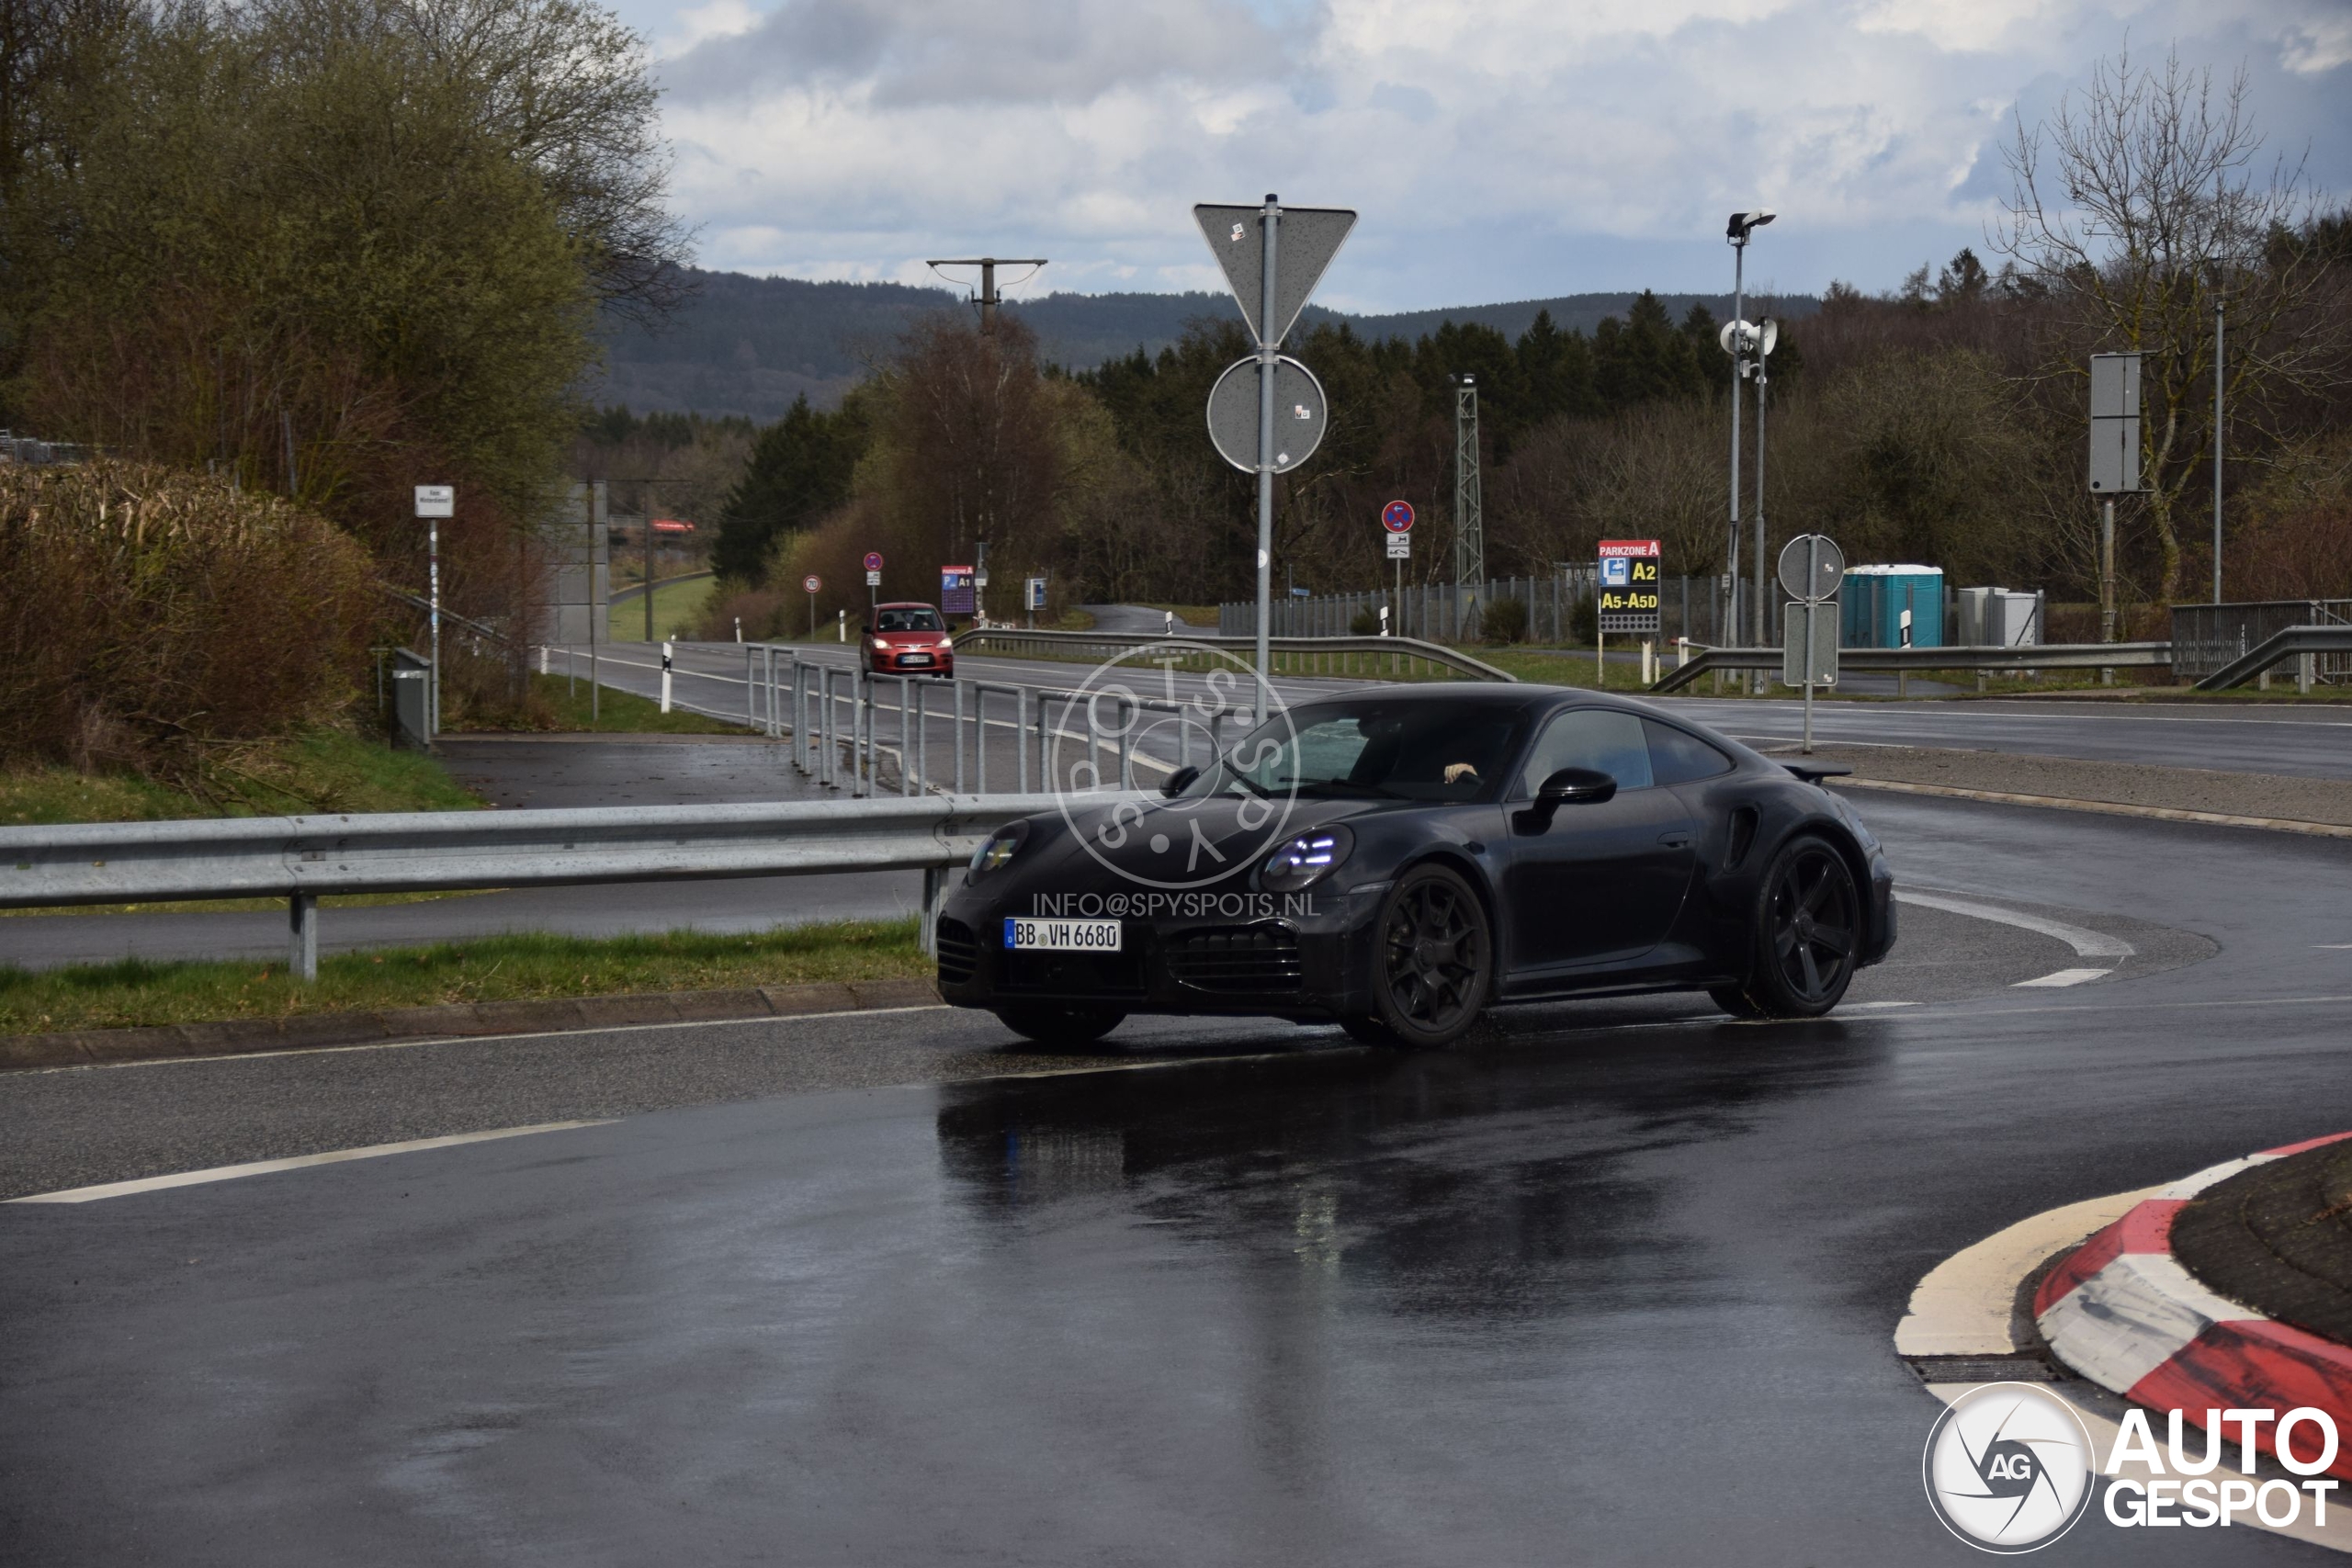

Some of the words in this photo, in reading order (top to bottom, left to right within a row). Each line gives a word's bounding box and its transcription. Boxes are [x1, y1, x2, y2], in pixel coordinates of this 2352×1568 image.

[1600, 546, 1647, 556] PARKZONE
[1648, 541, 1659, 556] A
[1632, 562, 1657, 581] A2
[958, 577, 970, 587] A1
[1601, 592, 1657, 609] A5-A5D
[1015, 923, 1036, 945] BB
[1048, 924, 1069, 946] VH
[1074, 924, 1116, 947] 6680
